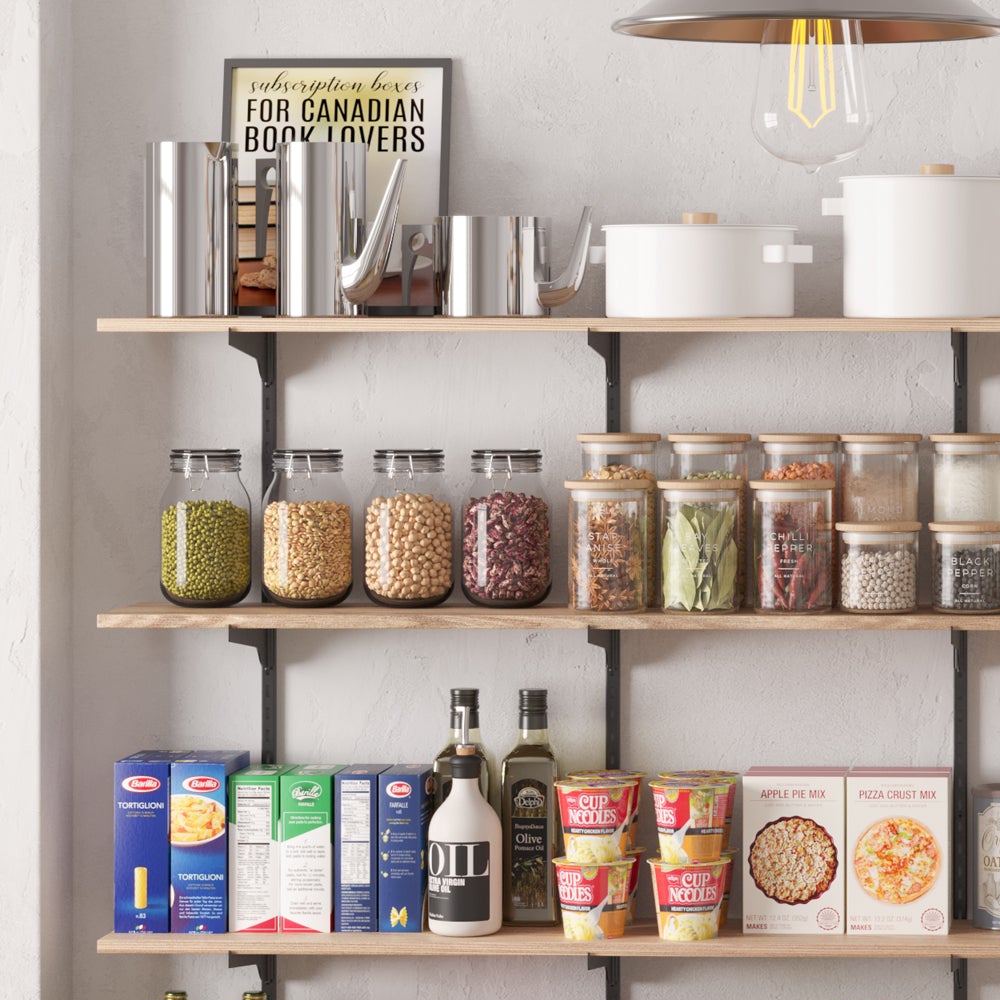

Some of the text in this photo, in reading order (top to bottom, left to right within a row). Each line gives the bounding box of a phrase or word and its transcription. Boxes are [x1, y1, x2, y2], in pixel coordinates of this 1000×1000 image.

[249, 71, 424, 99] subscription boxes
[247, 98, 424, 122] FOR CANADIAN
[244, 126, 315, 152] BOOK
[588, 532, 618, 541] STAR
[769, 532, 809, 541] CHILLI
[585, 543, 621, 552] ANISE
[951, 557, 990, 566] BLACK
[130, 780, 158, 788] Barilla
[191, 780, 217, 788] Barilla
[291, 785, 321, 800] Barilla
[760, 790, 826, 799] APPLE PIE MIX
[859, 790, 936, 800] PIZZA CRUST MIX
[580, 795, 608, 810] CUP
[569, 809, 616, 825] NOODLES
[516, 833, 542, 844] Olive
[429, 842, 489, 877] OIL
[442, 878, 465, 886] VIRGIN
[682, 873, 711, 887] CUP
[669, 886, 717, 902] NOODLES
